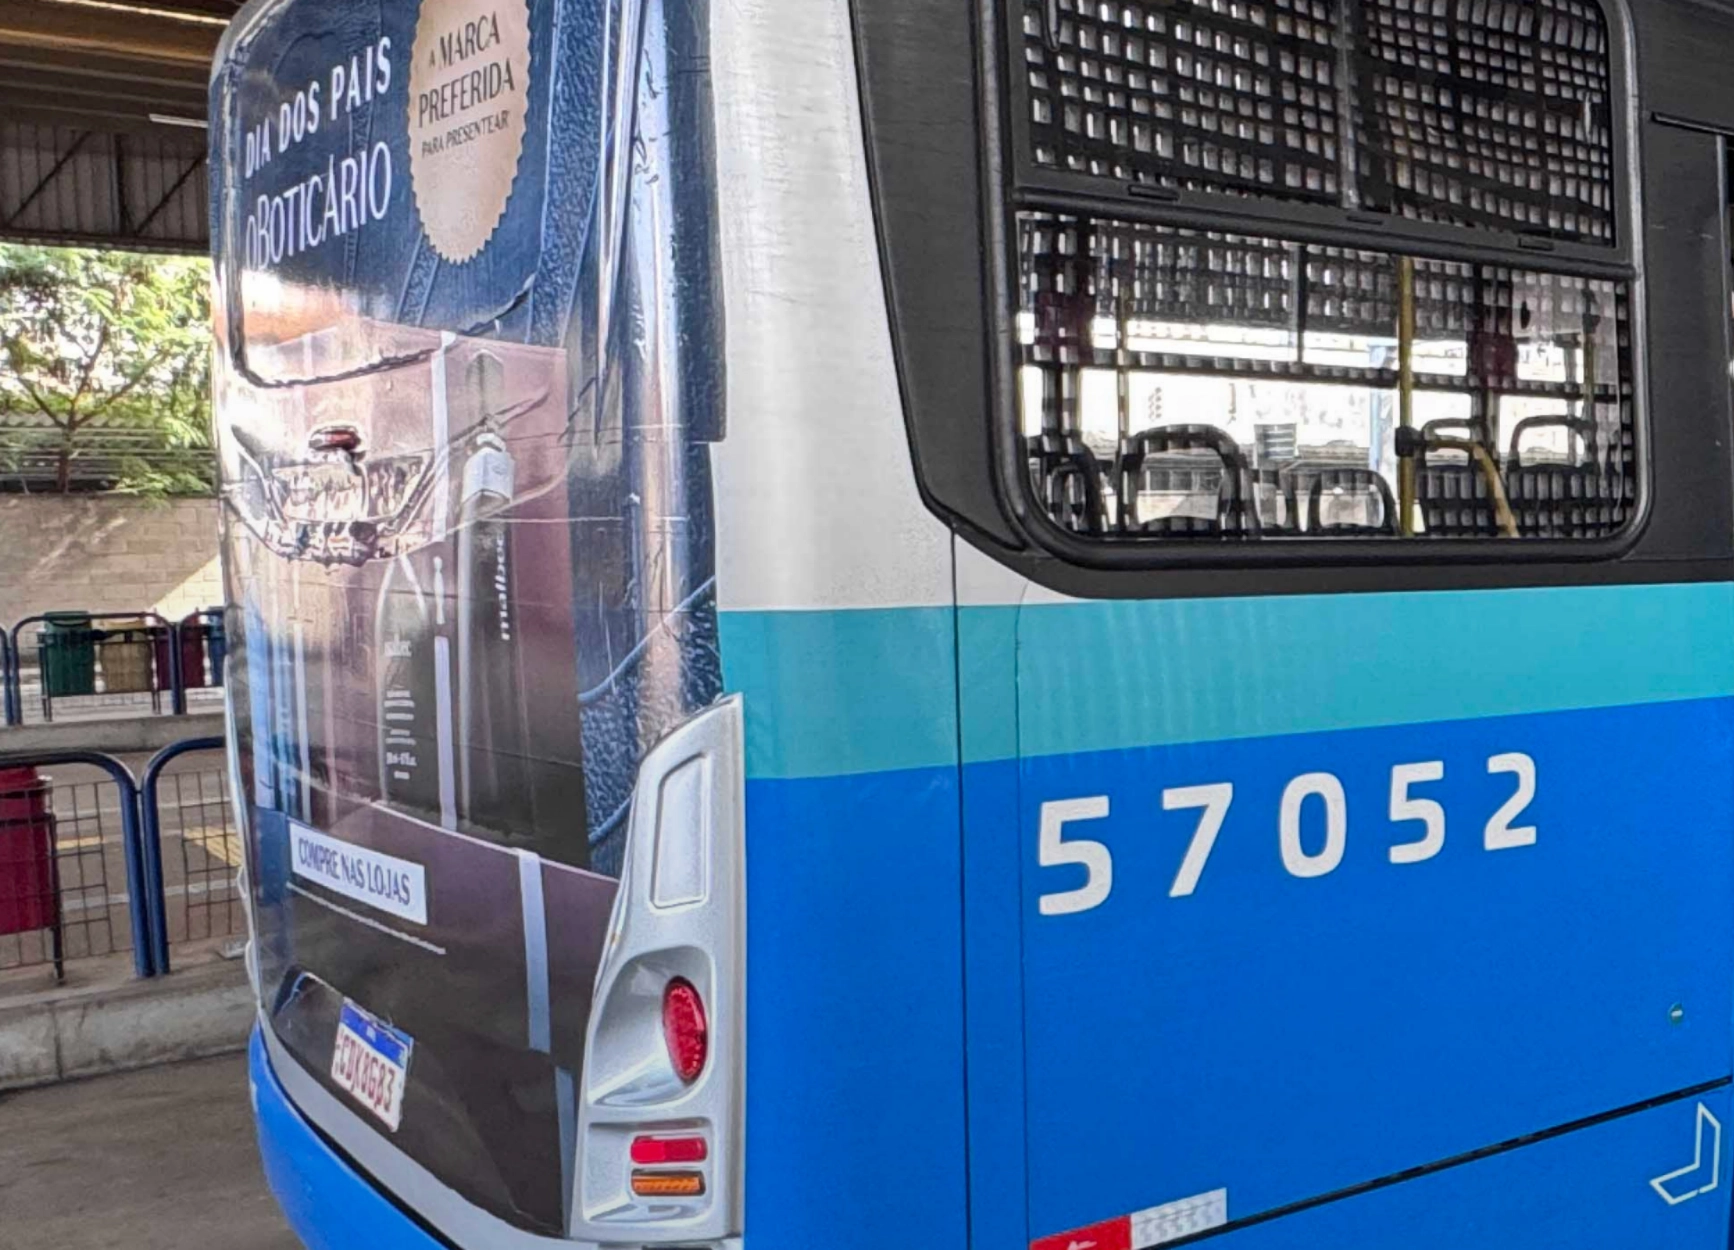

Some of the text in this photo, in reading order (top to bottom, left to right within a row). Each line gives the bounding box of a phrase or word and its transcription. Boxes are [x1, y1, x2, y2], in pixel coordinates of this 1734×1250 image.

[428, 10, 501, 70] A MARCA
[245, 36, 391, 179] DIA DOS PAIS
[418, 57, 516, 129] PREFERIDA
[421, 110, 511, 159] PARA PRESENTEAR
[1037, 752, 1537, 916] 57052
[298, 838, 411, 906] COMPRE NAS LOJAS
